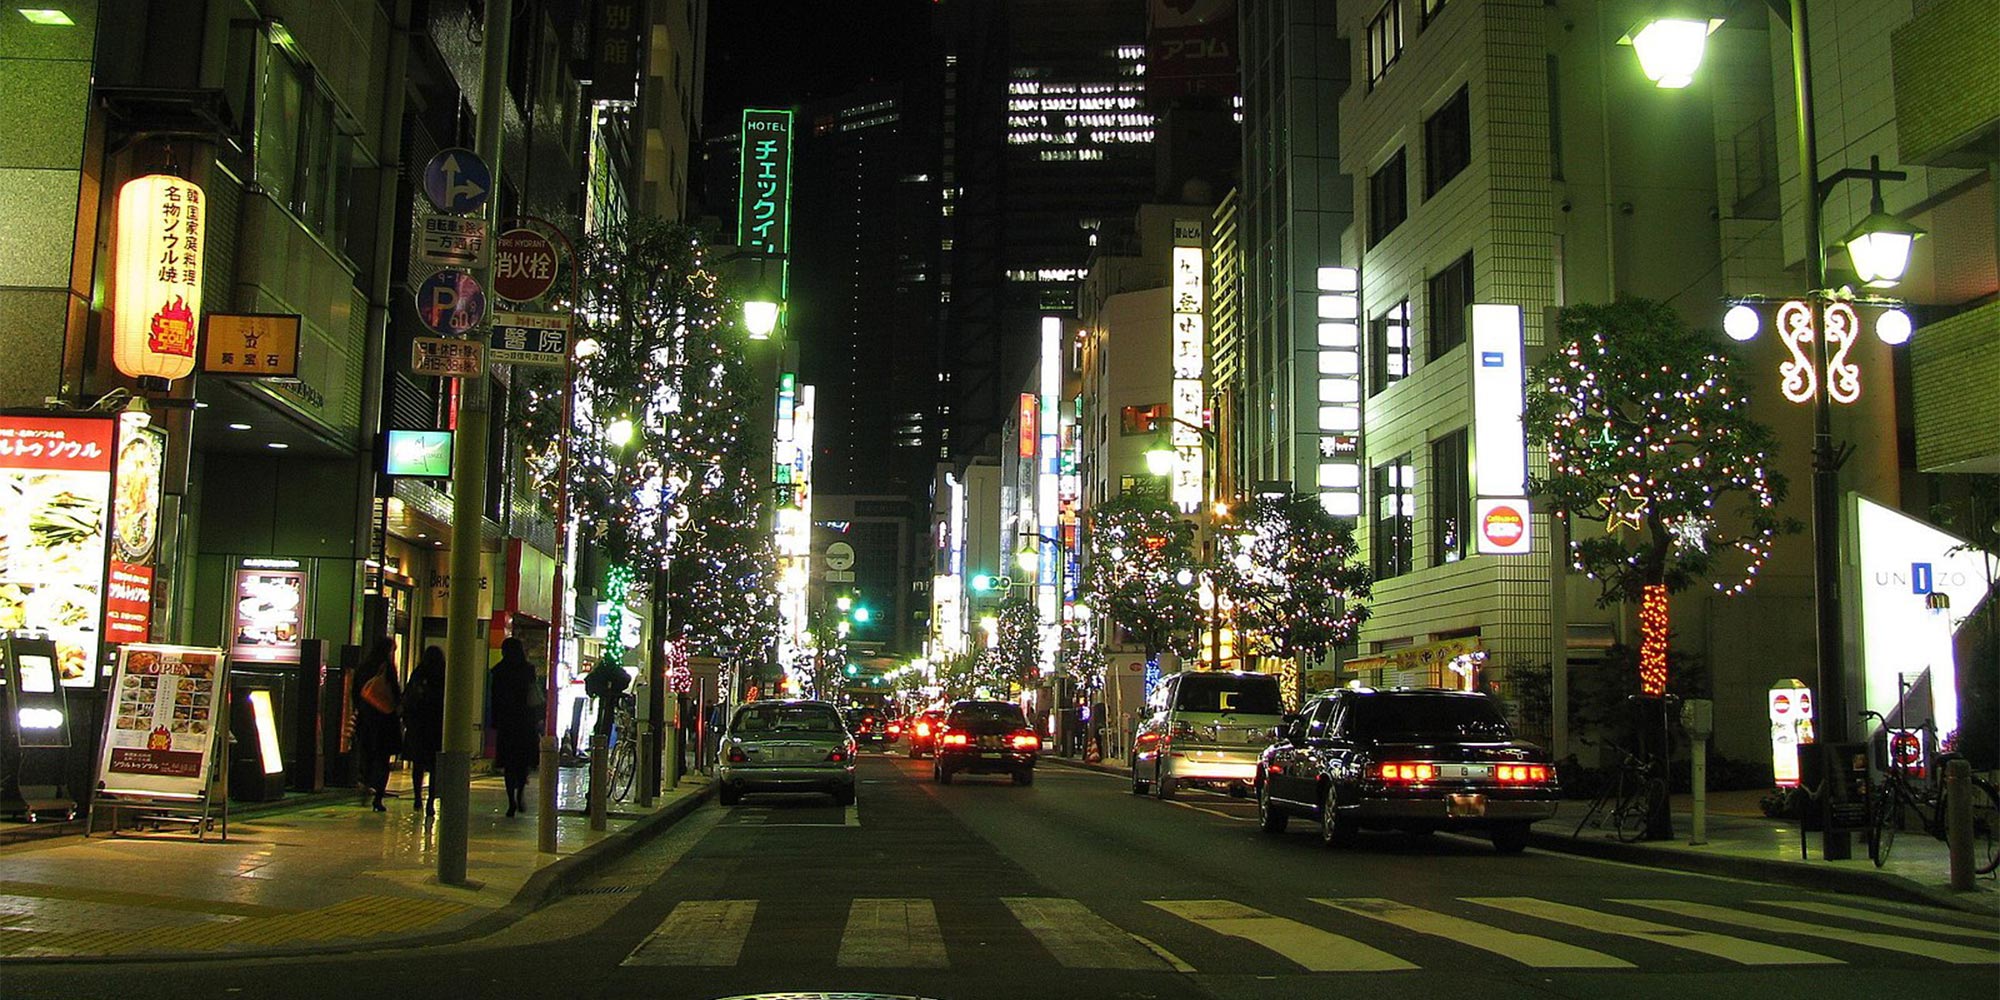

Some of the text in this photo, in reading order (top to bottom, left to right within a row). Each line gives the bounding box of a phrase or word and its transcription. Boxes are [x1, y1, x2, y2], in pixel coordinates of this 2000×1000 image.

[1161, 38, 1229, 60] アコム
[748, 121, 787, 132] HOTEL
[159, 186, 181, 284] 名物ソウル焼
[182, 188, 200, 287] 韓国家庭料理
[426, 219, 484, 236] 自転車を除く
[425, 235, 482, 251] 一方通行
[514, 239, 546, 248] HYDRANT
[495, 251, 552, 279] 消火栓
[432, 287, 459, 327] P
[1875, 568, 1966, 590] UNIZO
[149, 663, 193, 676] OPEN
